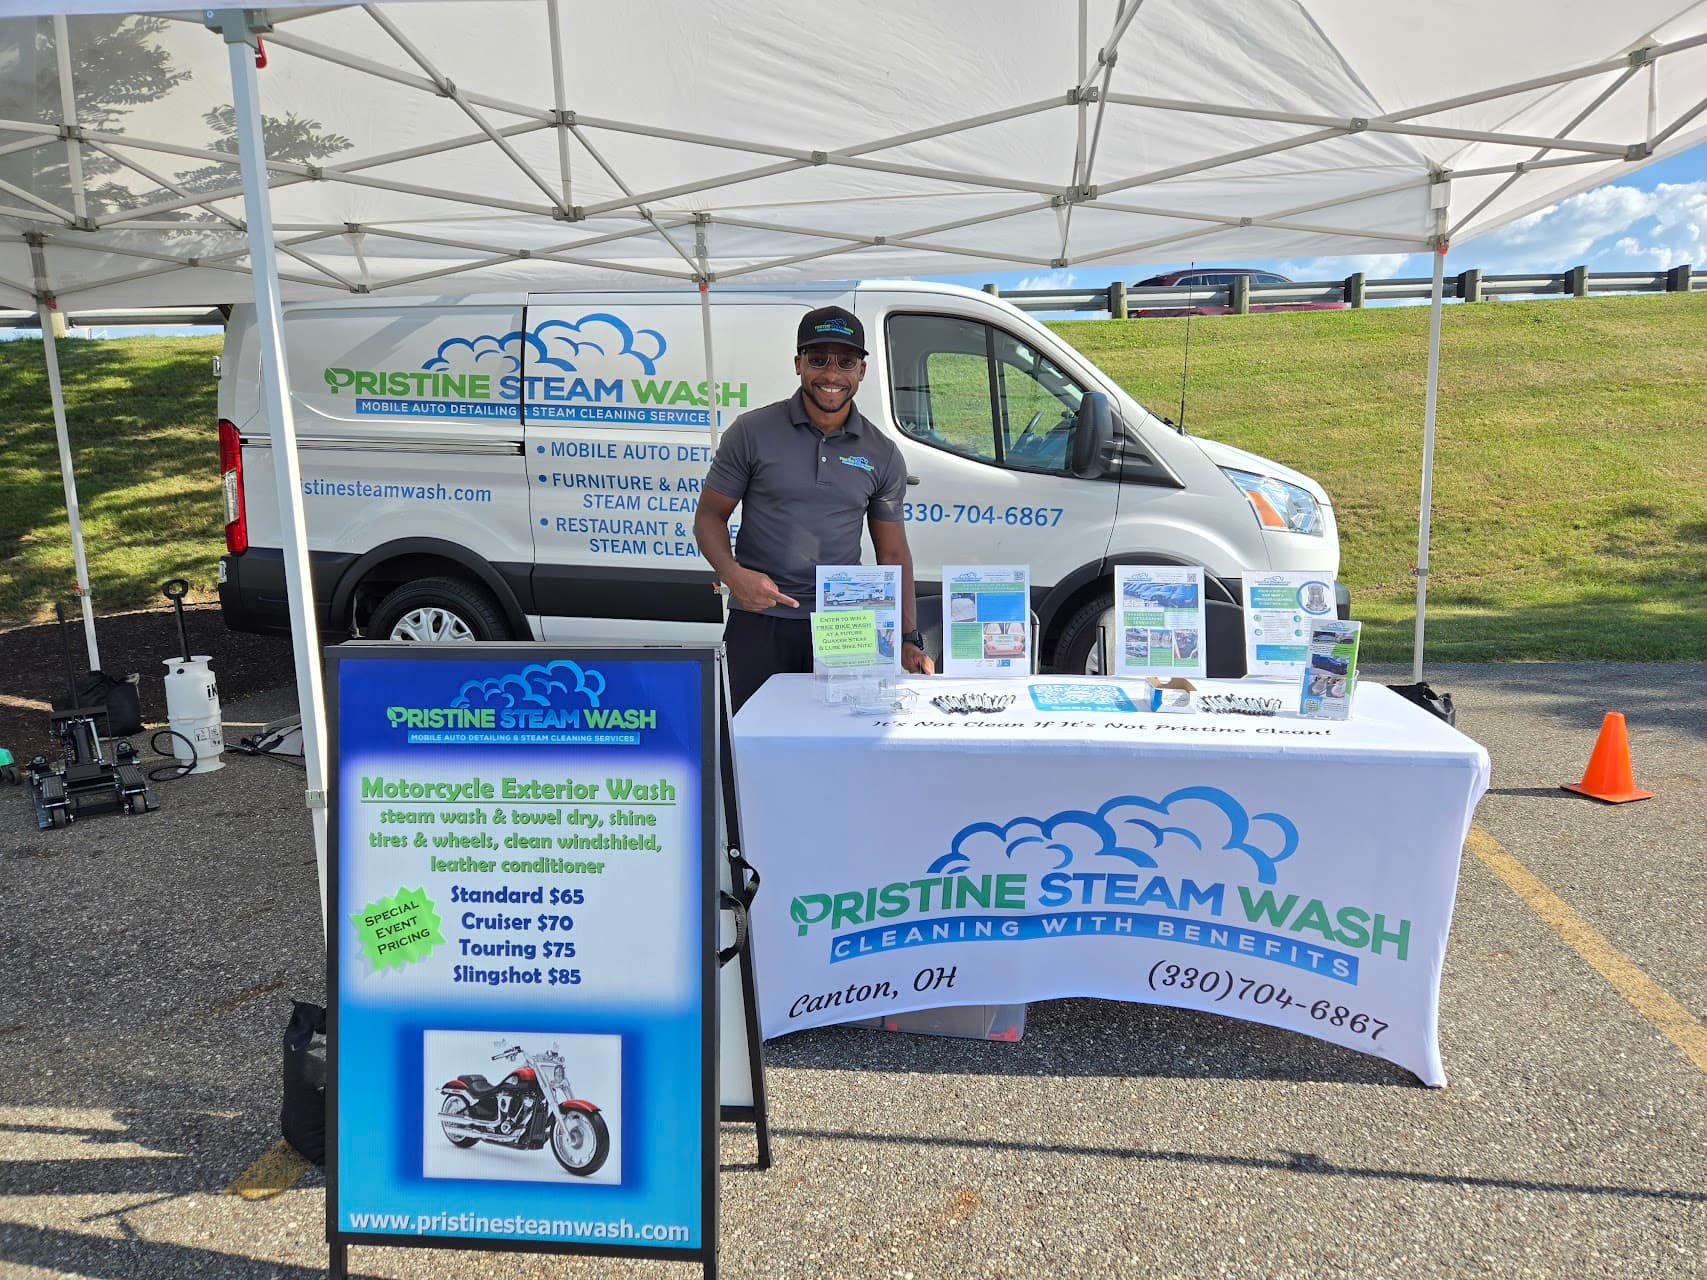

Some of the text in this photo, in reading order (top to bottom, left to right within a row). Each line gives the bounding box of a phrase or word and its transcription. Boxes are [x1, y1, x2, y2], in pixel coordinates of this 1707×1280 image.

[324, 367, 747, 408] PRISTINE STEAM WASH
[362, 401, 408, 413] MOBILE
[412, 403, 446, 414] AUTO
[450, 404, 517, 416] DETAILING
[532, 406, 576, 418] STEAM
[580, 408, 646, 420] CLEANING
[551, 442, 713, 462] MOBILE AUTO DET
[552, 472, 653, 491] FURNITURE
[659, 477, 671, 492] &
[583, 493, 641, 511] STEAM
[903, 503, 1064, 527] 330-704-6867
[556, 517, 686, 537] RESTAURANT &
[590, 538, 701, 557] STEAM CLEA
[387, 706, 657, 730] PRISTINE STEAM WASH
[872, 720, 1333, 736] It's Not Clean If It's Not Pristine Clean!
[411, 734, 442, 742] MOBILE
[444, 734, 467, 742] AUTO
[468, 734, 511, 742] DETAILING
[521, 734, 549, 742] STEAM
[551, 734, 593, 742] CLEANING
[361, 776, 676, 801] Motorcycle Exterior Wash
[380, 808, 657, 829] steam wash & towel dry, shine
[369, 831, 662, 853] tires & wheels, clean windshield,
[430, 856, 606, 874] leather conditioner
[450, 885, 585, 906] Standard $65
[364, 900, 420, 927] SPECIAL
[461, 911, 574, 933] Cruiser $70
[790, 872, 1411, 961] PRISTINE STEAM WASH
[375, 916, 418, 940] EVENT
[377, 928, 431, 956] PRICING
[458, 938, 576, 960] Touring $75
[834, 916, 1350, 977] CLEANING WITH BENEFITS
[453, 965, 582, 986] Slingshot $85
[788, 966, 957, 1019] Canton, OH
[1148, 960, 1389, 1041] (330)704-6867
[350, 1211, 690, 1242] www.pristinesteamwash.com
